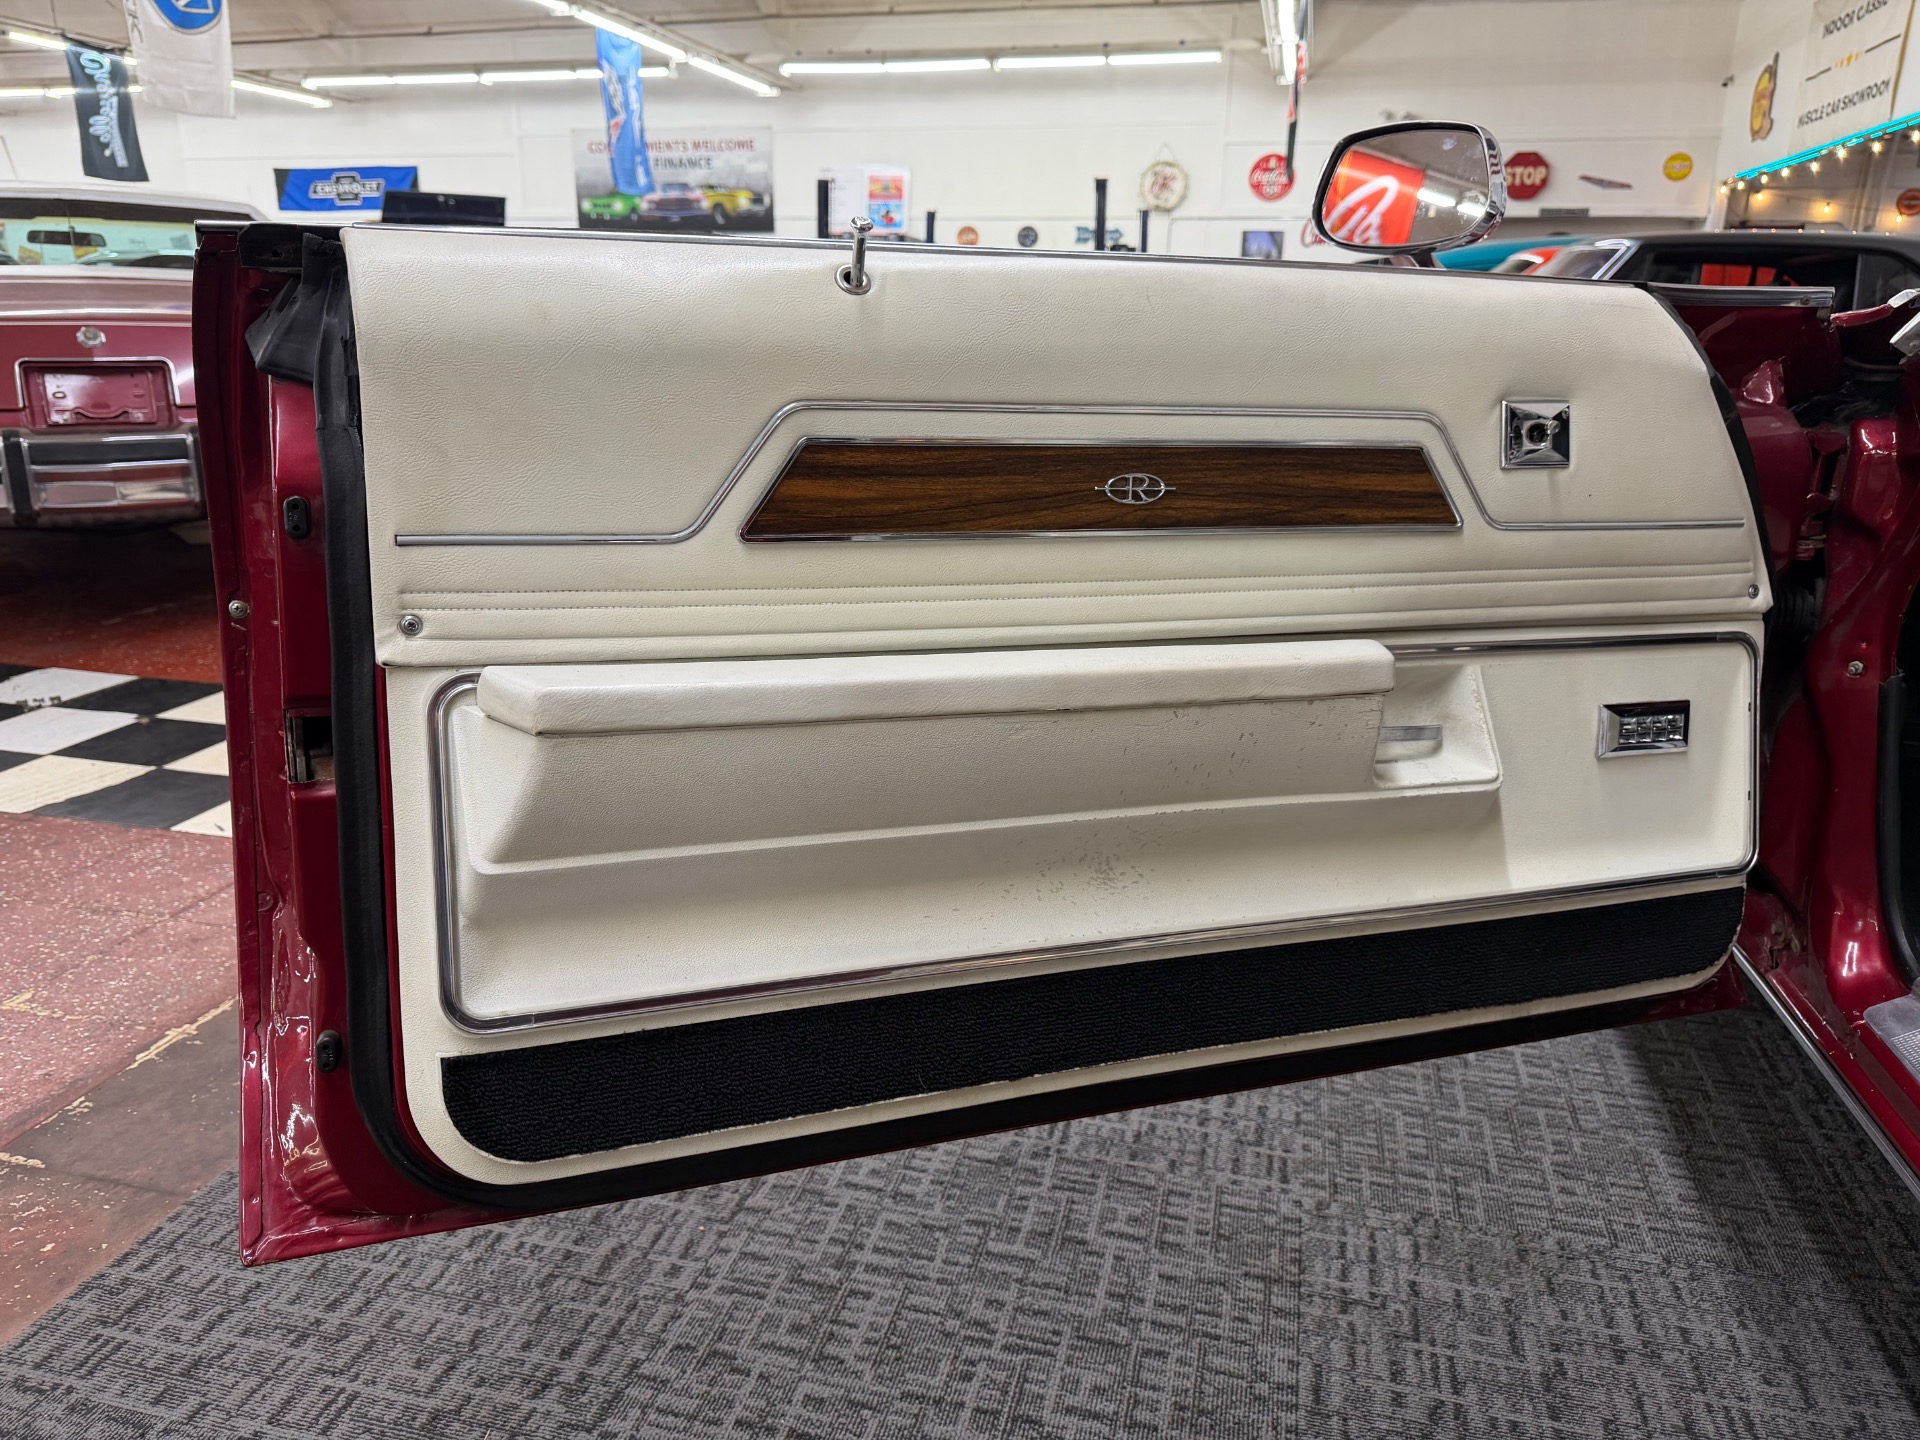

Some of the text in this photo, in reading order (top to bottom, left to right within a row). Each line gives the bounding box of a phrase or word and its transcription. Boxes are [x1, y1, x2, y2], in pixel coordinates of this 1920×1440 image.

[1825, 96, 1841, 117] CAR
[692, 139, 756, 153] WELCOME
[655, 156, 713, 170] FINANCE
[1505, 165, 1548, 187] STOP
